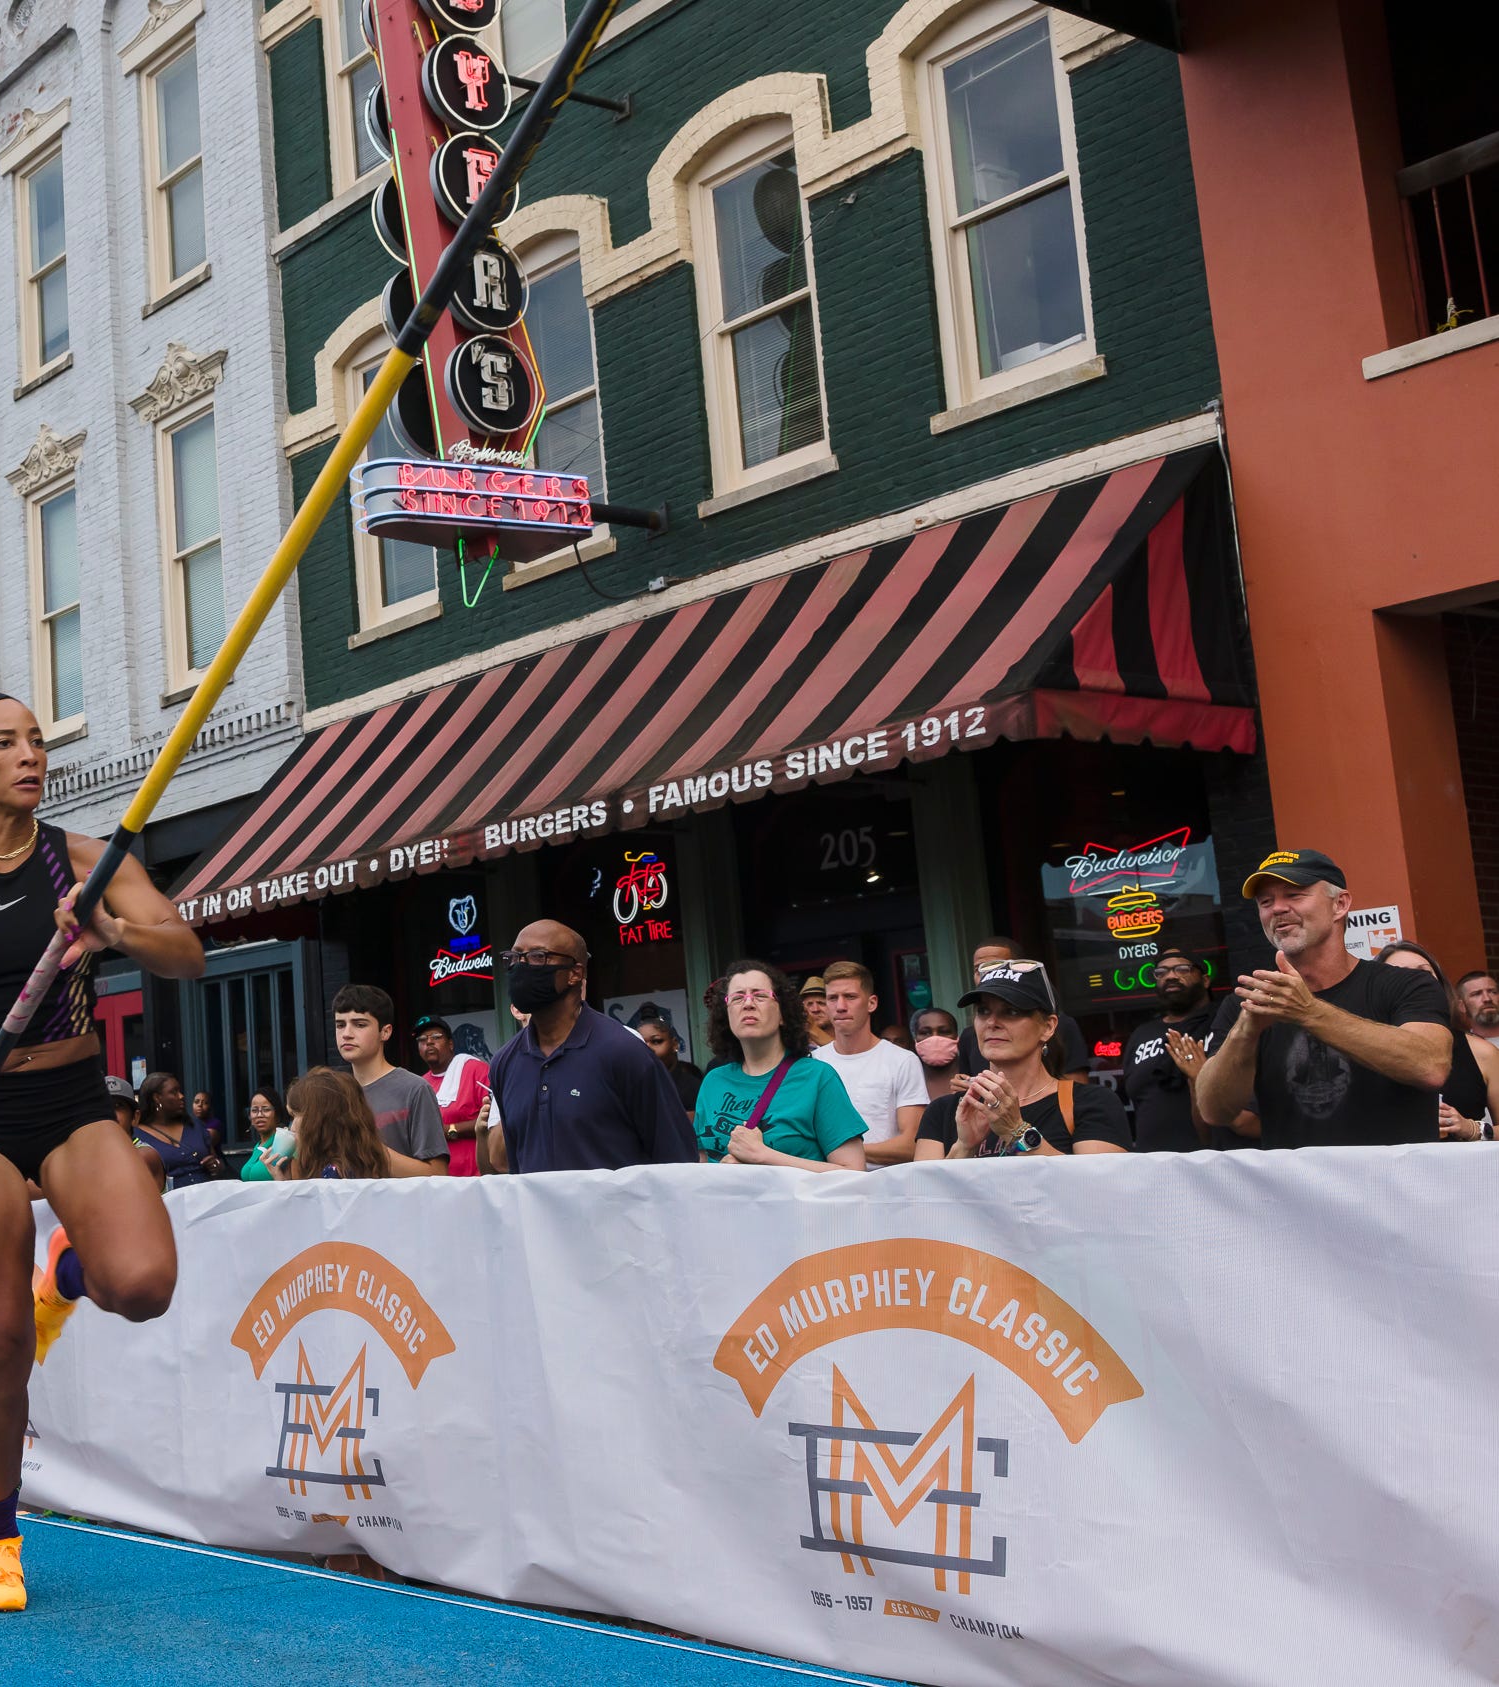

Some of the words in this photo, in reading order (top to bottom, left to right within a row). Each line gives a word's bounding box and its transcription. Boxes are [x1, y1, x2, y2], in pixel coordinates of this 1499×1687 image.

[398, 464, 590, 499] BURGERS
[401, 489, 503, 519] SINCE
[515, 499, 594, 526] 1912
[176, 901, 199, 922] AT
[202, 894, 221, 917] IN
[226, 887, 252, 911] OR
[257, 872, 308, 904] TAKE
[314, 860, 359, 890] OUT
[484, 800, 607, 850] BURGERS
[648, 759, 773, 814] FAMOUS
[785, 730, 888, 780] SINCE
[901, 706, 988, 752] 1912
[820, 825, 876, 870] 205
[1065, 847, 1186, 879] Budweiser
[1107, 910, 1164, 930] BURGERS
[1348, 912, 1391, 928] NING
[619, 924, 644, 945] FAT
[644, 920, 673, 940] TIRE
[1119, 943, 1158, 959] DYERS
[1346, 941, 1364, 949] ECURITY
[980, 969, 1023, 983] MEM
[252, 1309, 276, 1349] ED
[275, 1263, 350, 1320] MURPHEY
[355, 1269, 427, 1355] CLASSIC
[742, 1323, 780, 1375] ED
[778, 1268, 936, 1340] MURPHEY
[947, 1276, 1100, 1397] CLASSIC
[23, 1460, 43, 1472] MPION
[357, 1516, 403, 1533] CHAMPION
[811, 1590, 833, 1608] 1955
[845, 1596, 873, 1611] 1957
[891, 1602, 910, 1615] SEC
[913, 1607, 934, 1620] MILE
[950, 1614, 1025, 1640] CHAMPION
